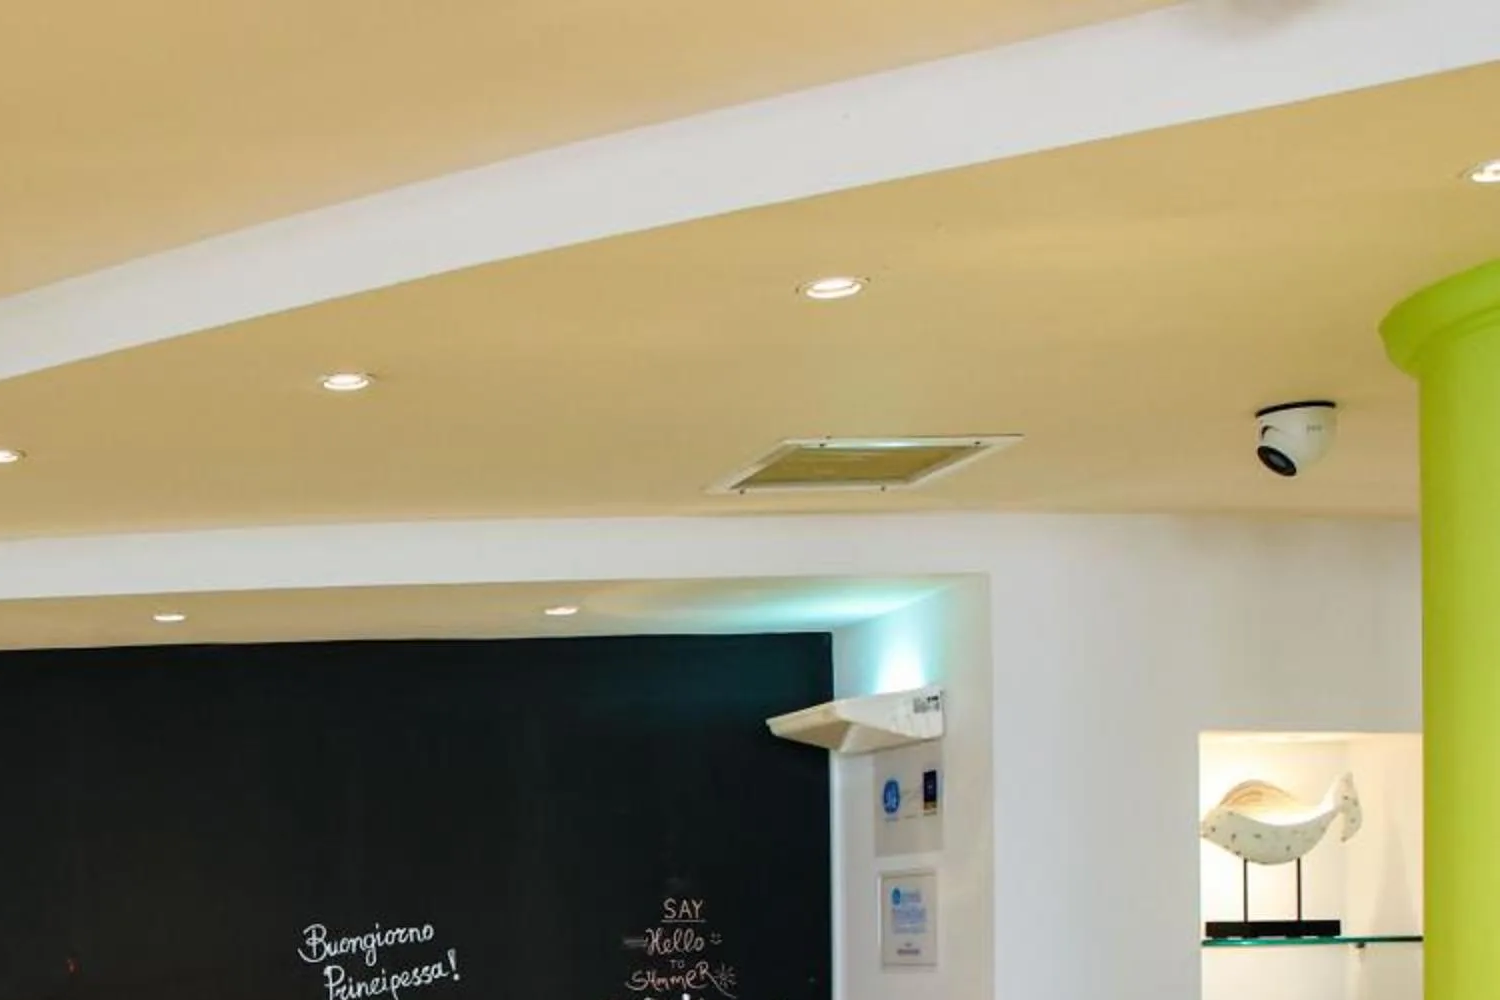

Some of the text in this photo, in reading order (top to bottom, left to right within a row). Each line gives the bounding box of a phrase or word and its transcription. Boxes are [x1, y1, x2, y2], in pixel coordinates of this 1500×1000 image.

[663, 898, 704, 919] SAY
[298, 922, 435, 966] Buongiorno
[645, 928, 705, 956] Hello
